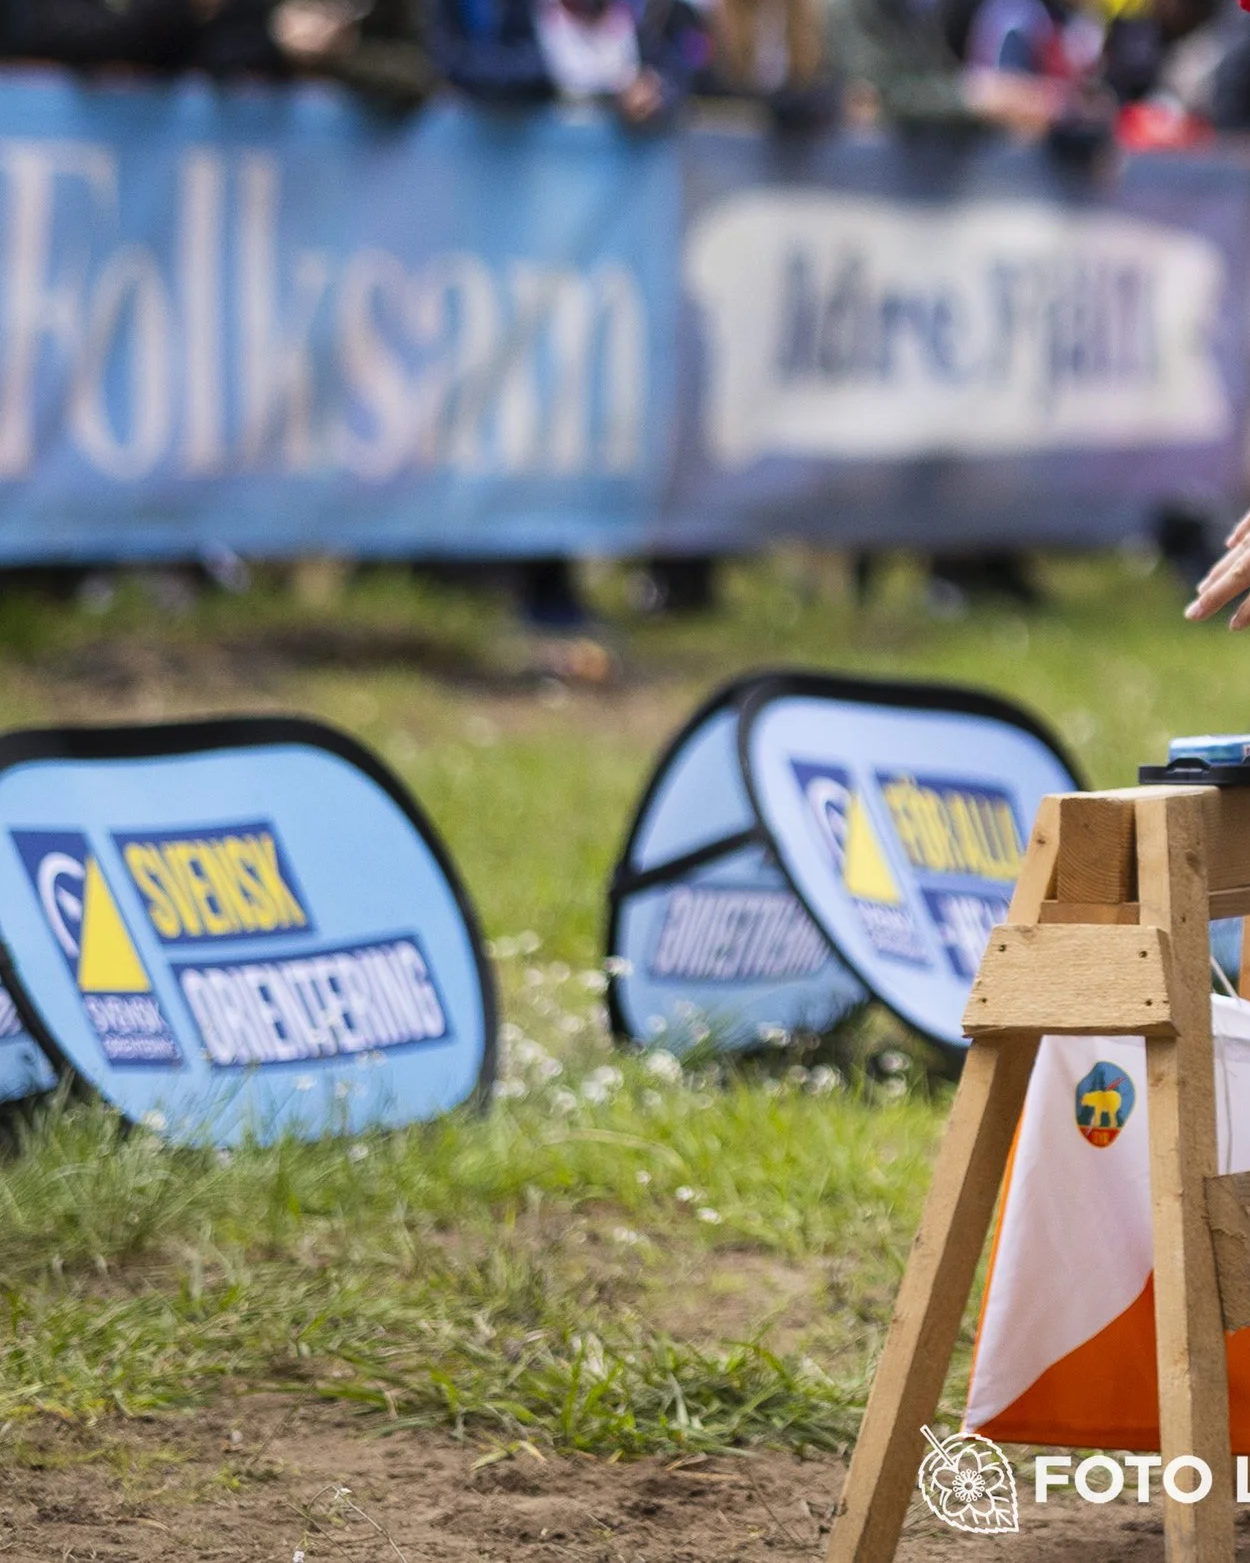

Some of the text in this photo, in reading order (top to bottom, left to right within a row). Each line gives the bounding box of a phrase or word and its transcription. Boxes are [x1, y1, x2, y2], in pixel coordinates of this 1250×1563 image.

[0, 138, 651, 483] Folksam
[123, 831, 307, 940] SVENSK
[179, 938, 446, 1068] ORIENTERING
